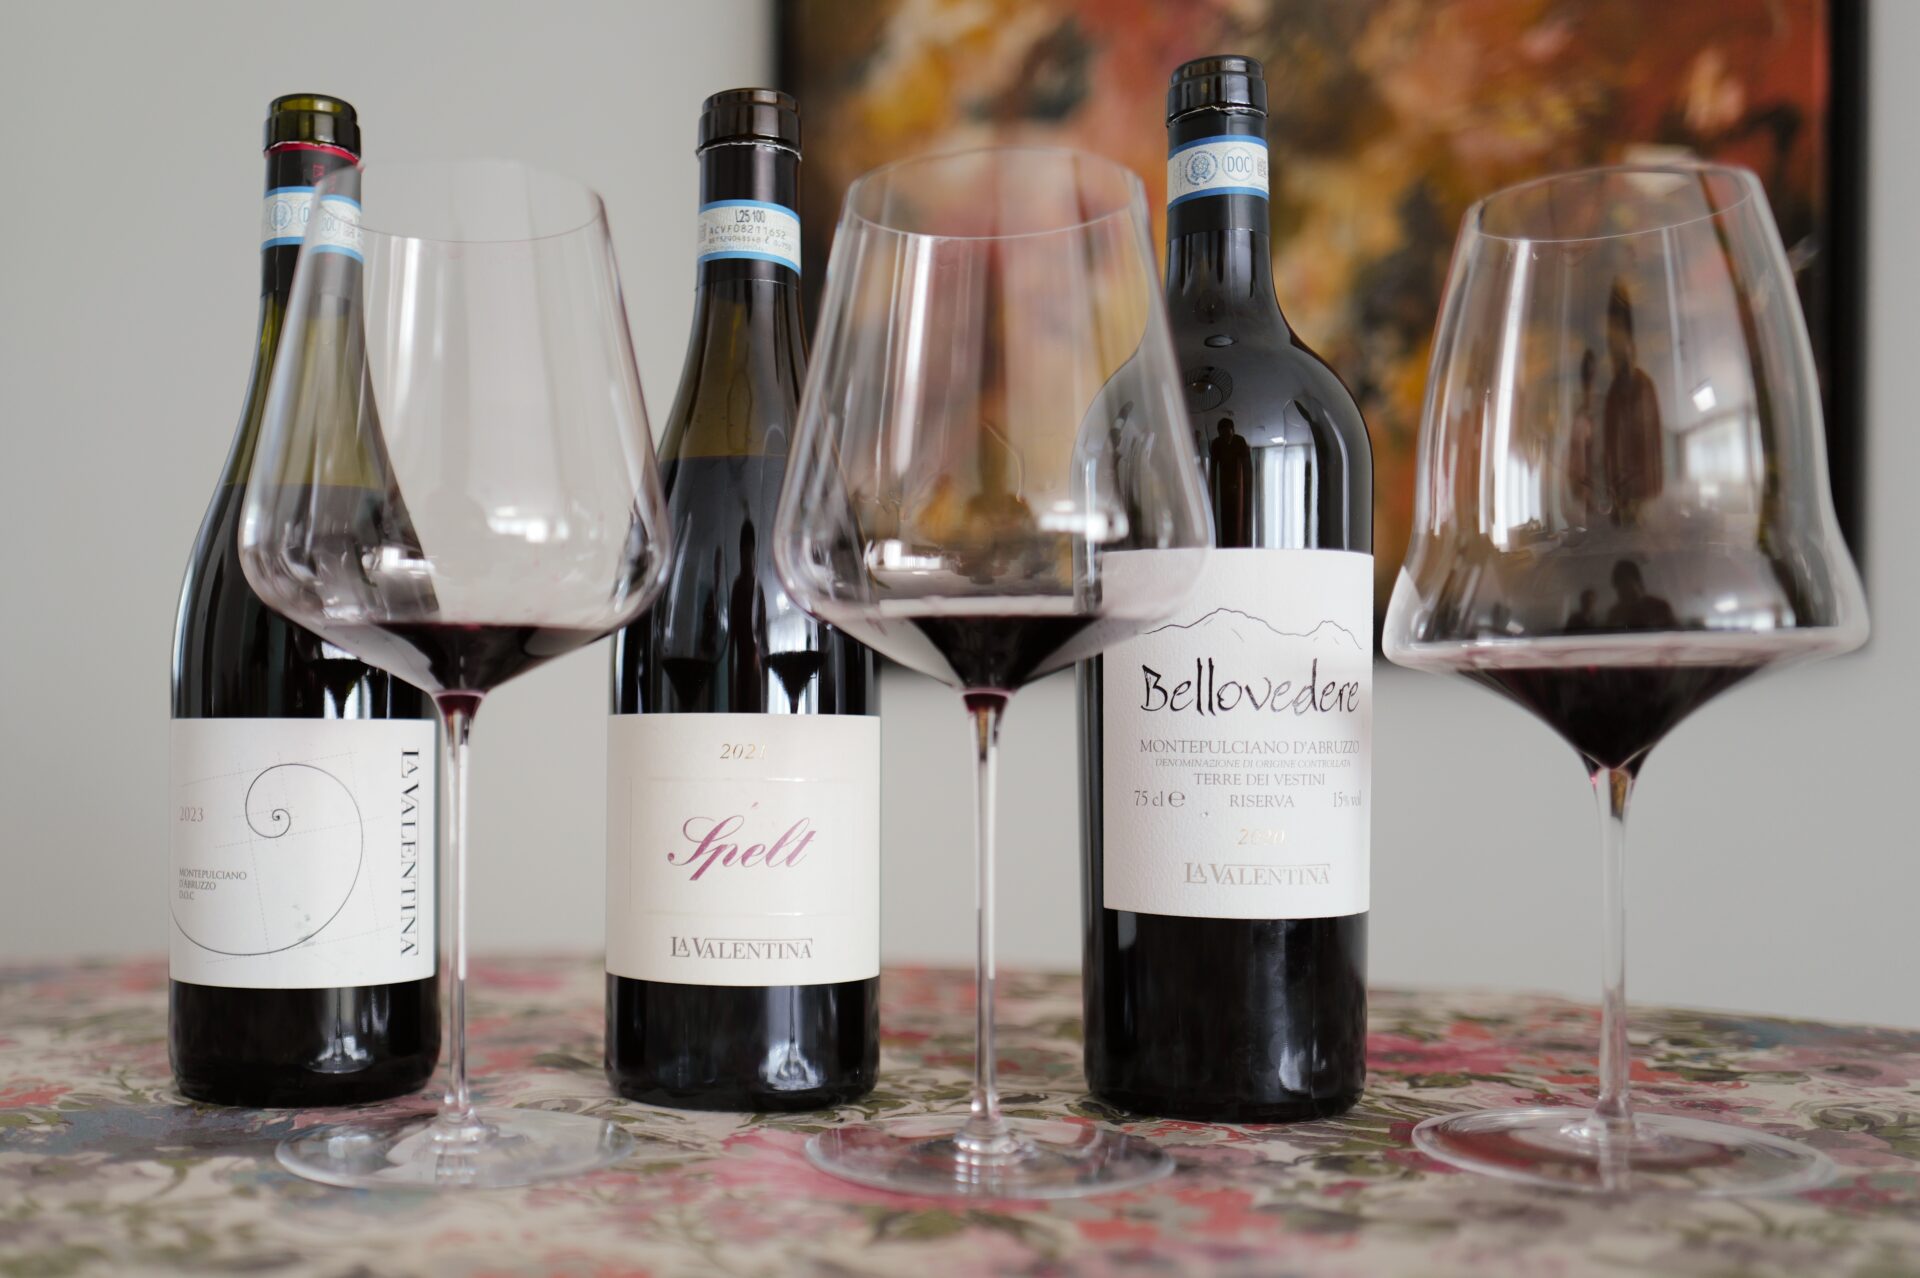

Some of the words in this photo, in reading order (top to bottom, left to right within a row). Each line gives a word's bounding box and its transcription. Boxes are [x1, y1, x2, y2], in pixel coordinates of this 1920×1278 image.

[1227, 156, 1250, 173] DOC
[1141, 657, 1359, 716] Bellovedere
[1140, 740, 1289, 754] MONTEPULCIANO
[1294, 740, 1360, 754] D'ABRUZZO
[401, 747, 418, 778] LA
[1155, 759, 1240, 768] DENOMINAZIONE
[1243, 760, 1253, 769] DI
[1255, 760, 1295, 769] ORIGINE
[1194, 773, 1242, 785] TERRE
[1246, 773, 1269, 786] DEI
[1274, 773, 1325, 786] VESTINI
[1134, 791, 1148, 806] 75
[1152, 791, 1164, 807] cl
[1229, 795, 1295, 808] RISERVA
[179, 807, 204, 822] 2023
[667, 815, 816, 881] Spelt
[179, 868, 247, 880] MONTEPULCIANO
[401, 781, 418, 956] VALENTINA
[1184, 863, 1207, 884] LA
[1208, 863, 1331, 885] VALENTINA
[670, 936, 690, 957] LA
[691, 937, 813, 960] VALENTINA
